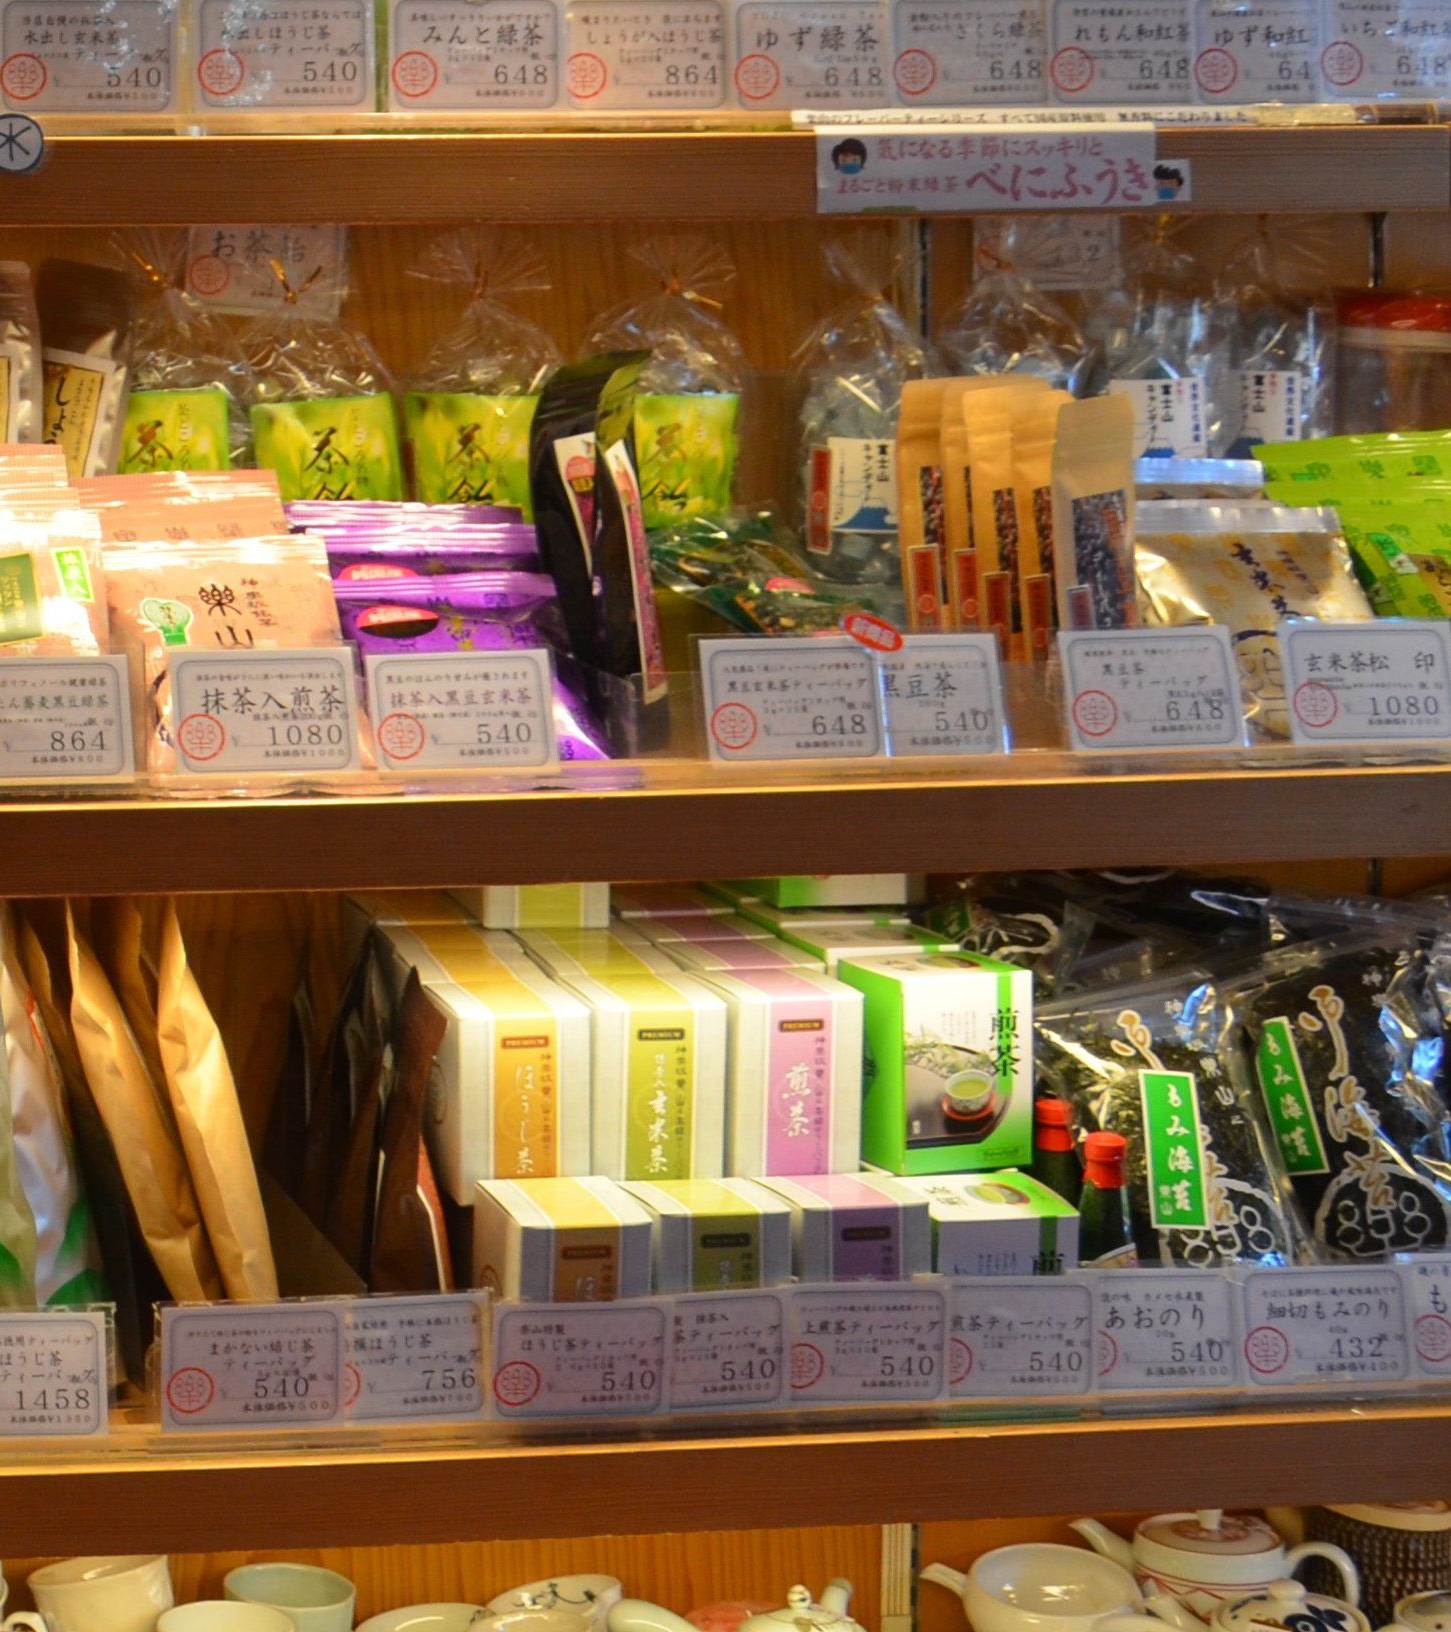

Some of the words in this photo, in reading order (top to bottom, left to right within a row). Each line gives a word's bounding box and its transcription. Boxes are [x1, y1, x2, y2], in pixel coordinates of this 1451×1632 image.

[423, 24, 543, 45] みんと緑茶
[755, 27, 880, 53] ゆず緑茶
[665, 65, 719, 85] 864
[966, 158, 1147, 205] べにふうき
[200, 685, 345, 717] 抹茶入煎茶
[390, 688, 532, 706] 抹茶入黒豆玄米茶
[1369, 696, 1439, 718] 1080
[49, 729, 107, 752] 864
[268, 724, 344, 746] 1080
[640, 1029, 683, 1041] PREMIUM
[780, 1019, 824, 1032] PREMIUM
[504, 1037, 548, 1048] PREMIUM
[987, 1007, 1027, 1078] 煎茶
[782, 1061, 814, 1140] 煎茶
[1105, 1305, 1205, 1333] あおのり
[1329, 1338, 1383, 1358] 432
[0, 1352, 63, 1367] ほうじ茶
[423, 1369, 477, 1390] 756
[16, 1388, 90, 1411] 1458
